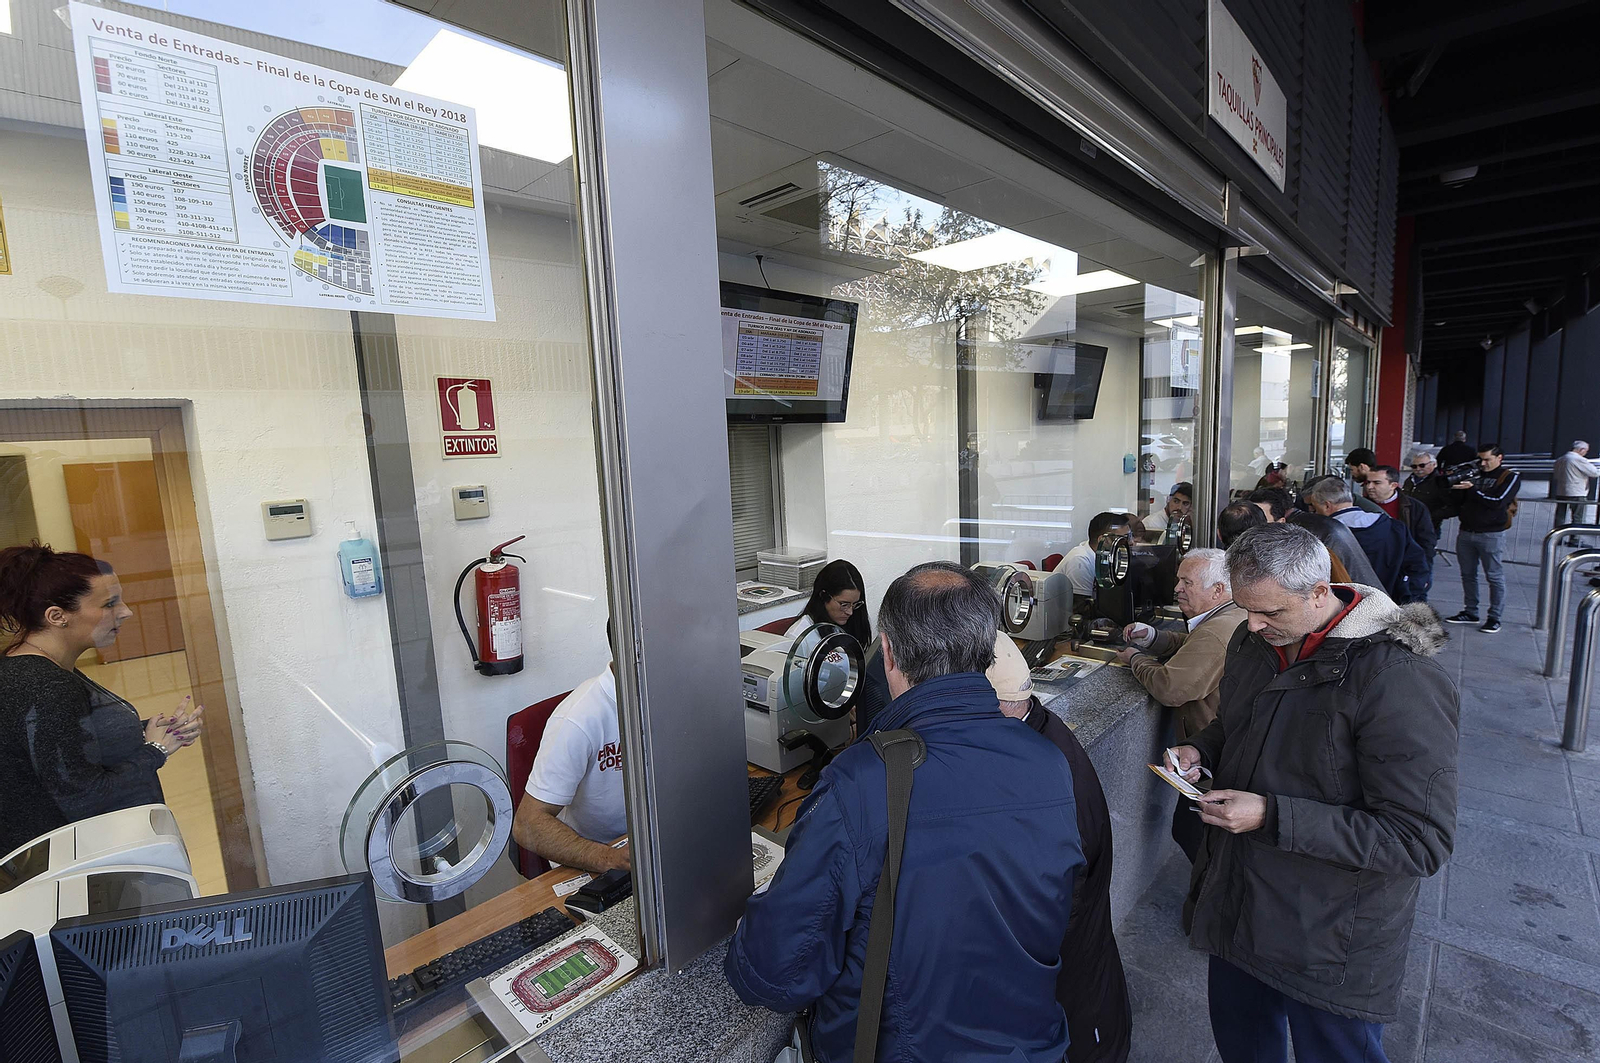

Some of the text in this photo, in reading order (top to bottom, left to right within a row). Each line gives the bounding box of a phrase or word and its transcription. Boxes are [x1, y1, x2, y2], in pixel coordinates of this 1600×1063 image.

[109, 53, 186, 75] Precio Sectores
[134, 50, 177, 64] Fondo Norte
[91, 17, 143, 41] Venta
[147, 31, 168, 47] de
[172, 38, 239, 65] Entradas
[256, 59, 288, 77] Final
[293, 69, 309, 83] de
[313, 74, 324, 87] la
[329, 79, 360, 98] Copa
[363, 87, 378, 100] de
[381, 92, 400, 106] SM
[403, 98, 413, 109] el
[417, 102, 437, 117] Rey
[440, 108, 466, 123] 2018
[143, 110, 167, 119] Lateral
[1217, 71, 1284, 169] TAQUILLAS PRINCIPALES
[117, 114, 193, 132] Precio Sectores
[168, 156, 194, 165] 423-424
[241, 154, 251, 173] NORTE
[148, 167, 171, 175] Lateral
[124, 172, 200, 188] Precio Sectores
[174, 196, 212, 206] 108-109-110
[396, 198, 452, 212] CONSULTAS FRECUENTES
[176, 212, 214, 222] 310-311-312
[131, 236, 189, 247] RECOMENDACIONES
[445, 438, 496, 452] EXTINTOR
[824, 652, 843, 662] OPA
[161, 916, 252, 954] DELL
